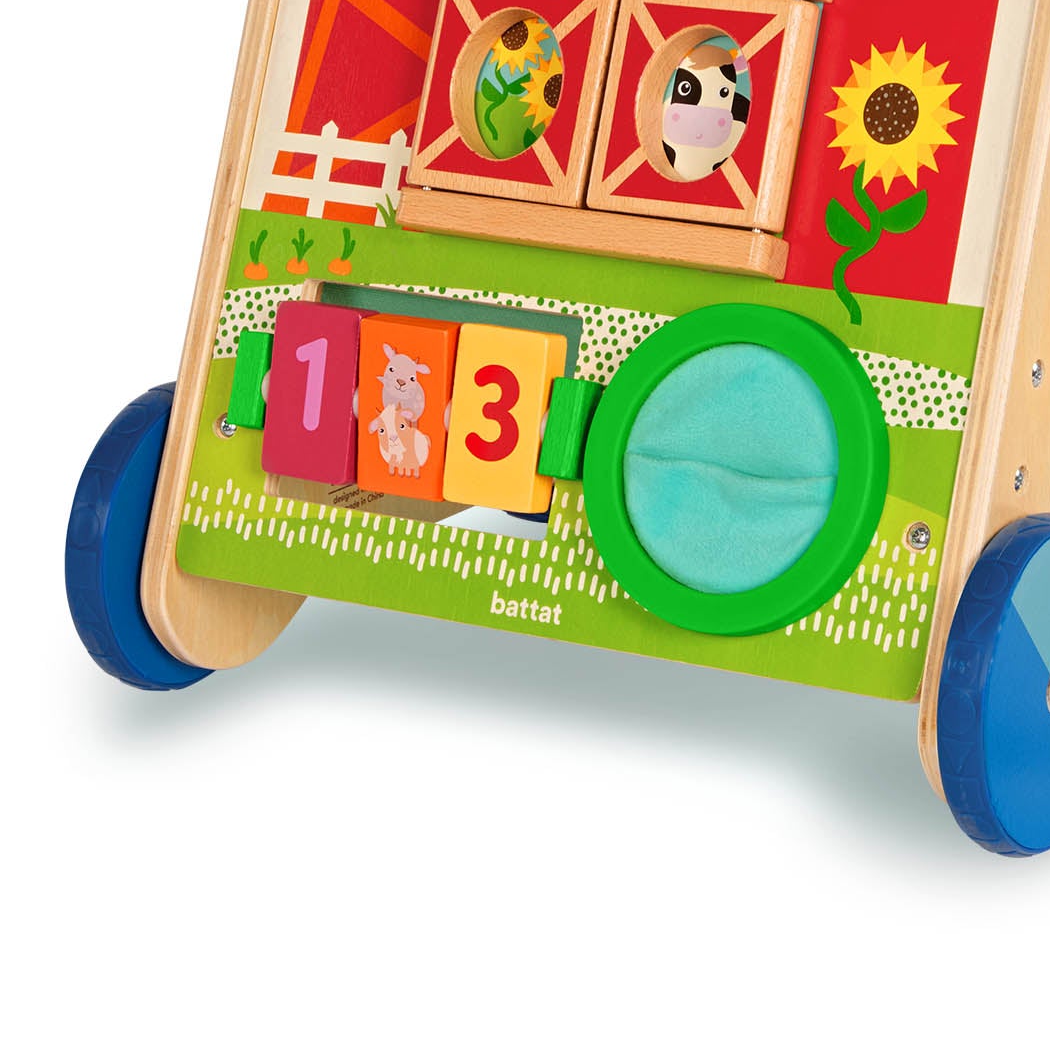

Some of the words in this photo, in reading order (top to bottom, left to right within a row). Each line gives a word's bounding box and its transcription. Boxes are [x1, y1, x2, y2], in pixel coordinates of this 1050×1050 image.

[296, 338, 328, 431] 1
[465, 364, 520, 462] 3
[490, 590, 563, 625] battat
